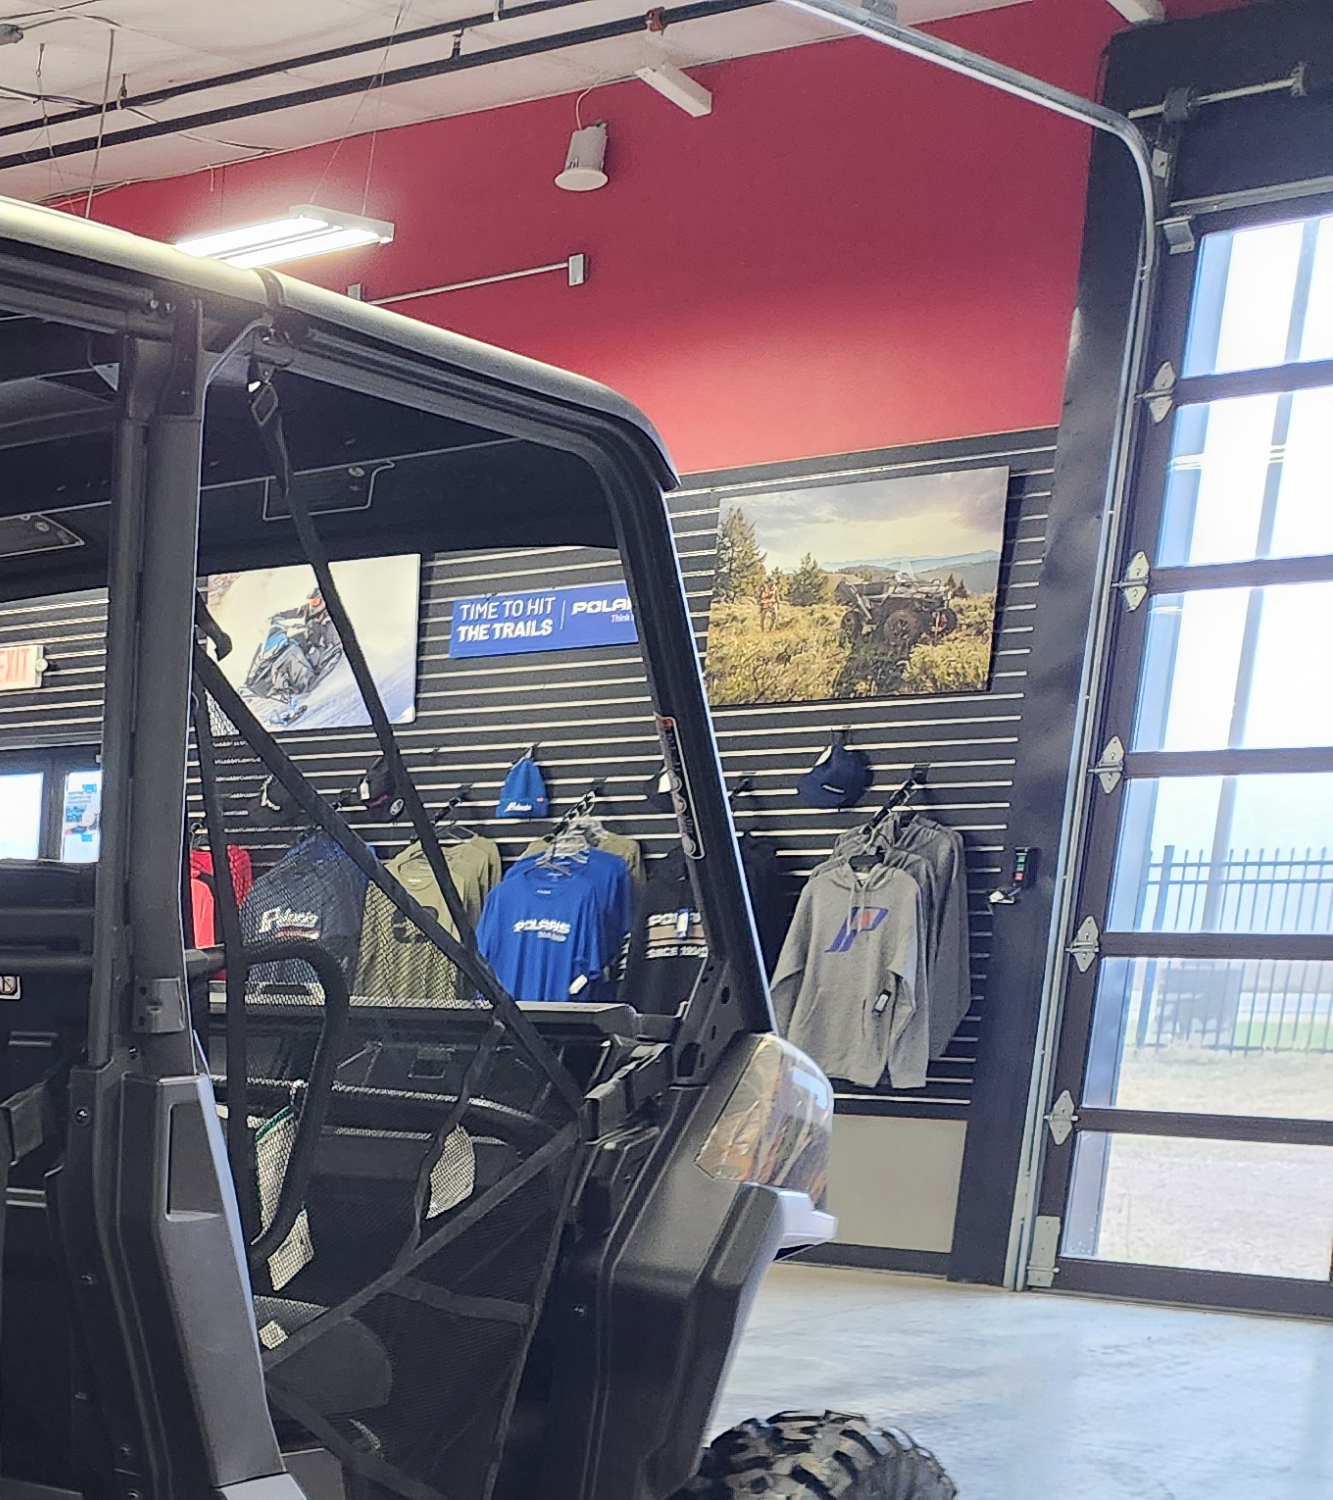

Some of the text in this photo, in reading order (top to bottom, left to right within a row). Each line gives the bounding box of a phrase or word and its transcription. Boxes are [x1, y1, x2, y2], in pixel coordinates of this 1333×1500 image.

[459, 596, 556, 622] TIME TO HIT
[456, 619, 553, 643] THE TRAILS
[513, 918, 571, 934] POLARIS
